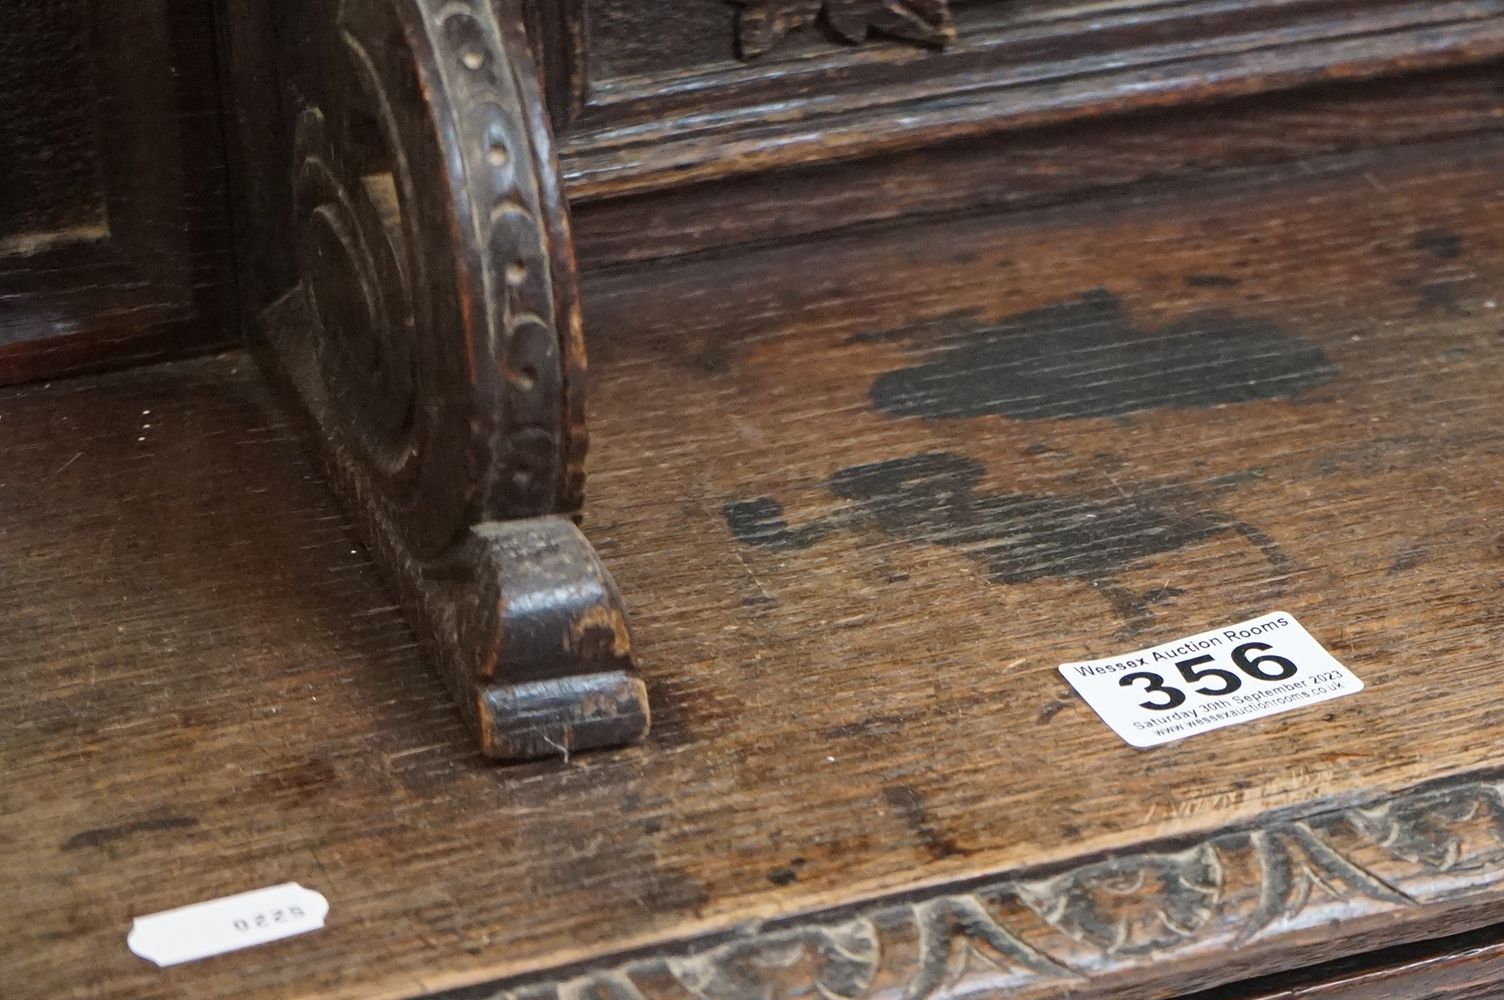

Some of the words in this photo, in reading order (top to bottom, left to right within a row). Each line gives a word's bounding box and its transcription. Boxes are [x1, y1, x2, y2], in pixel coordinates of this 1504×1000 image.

[1074, 658, 1148, 677] Wessex
[1151, 636, 1223, 662] Auction
[1222, 617, 1289, 642] Rooms
[1118, 641, 1298, 711] 356
[1132, 708, 1199, 730] Saturday
[1198, 698, 1231, 714] 30th
[1231, 679, 1310, 704] September
[1308, 669, 1344, 685] 2023
